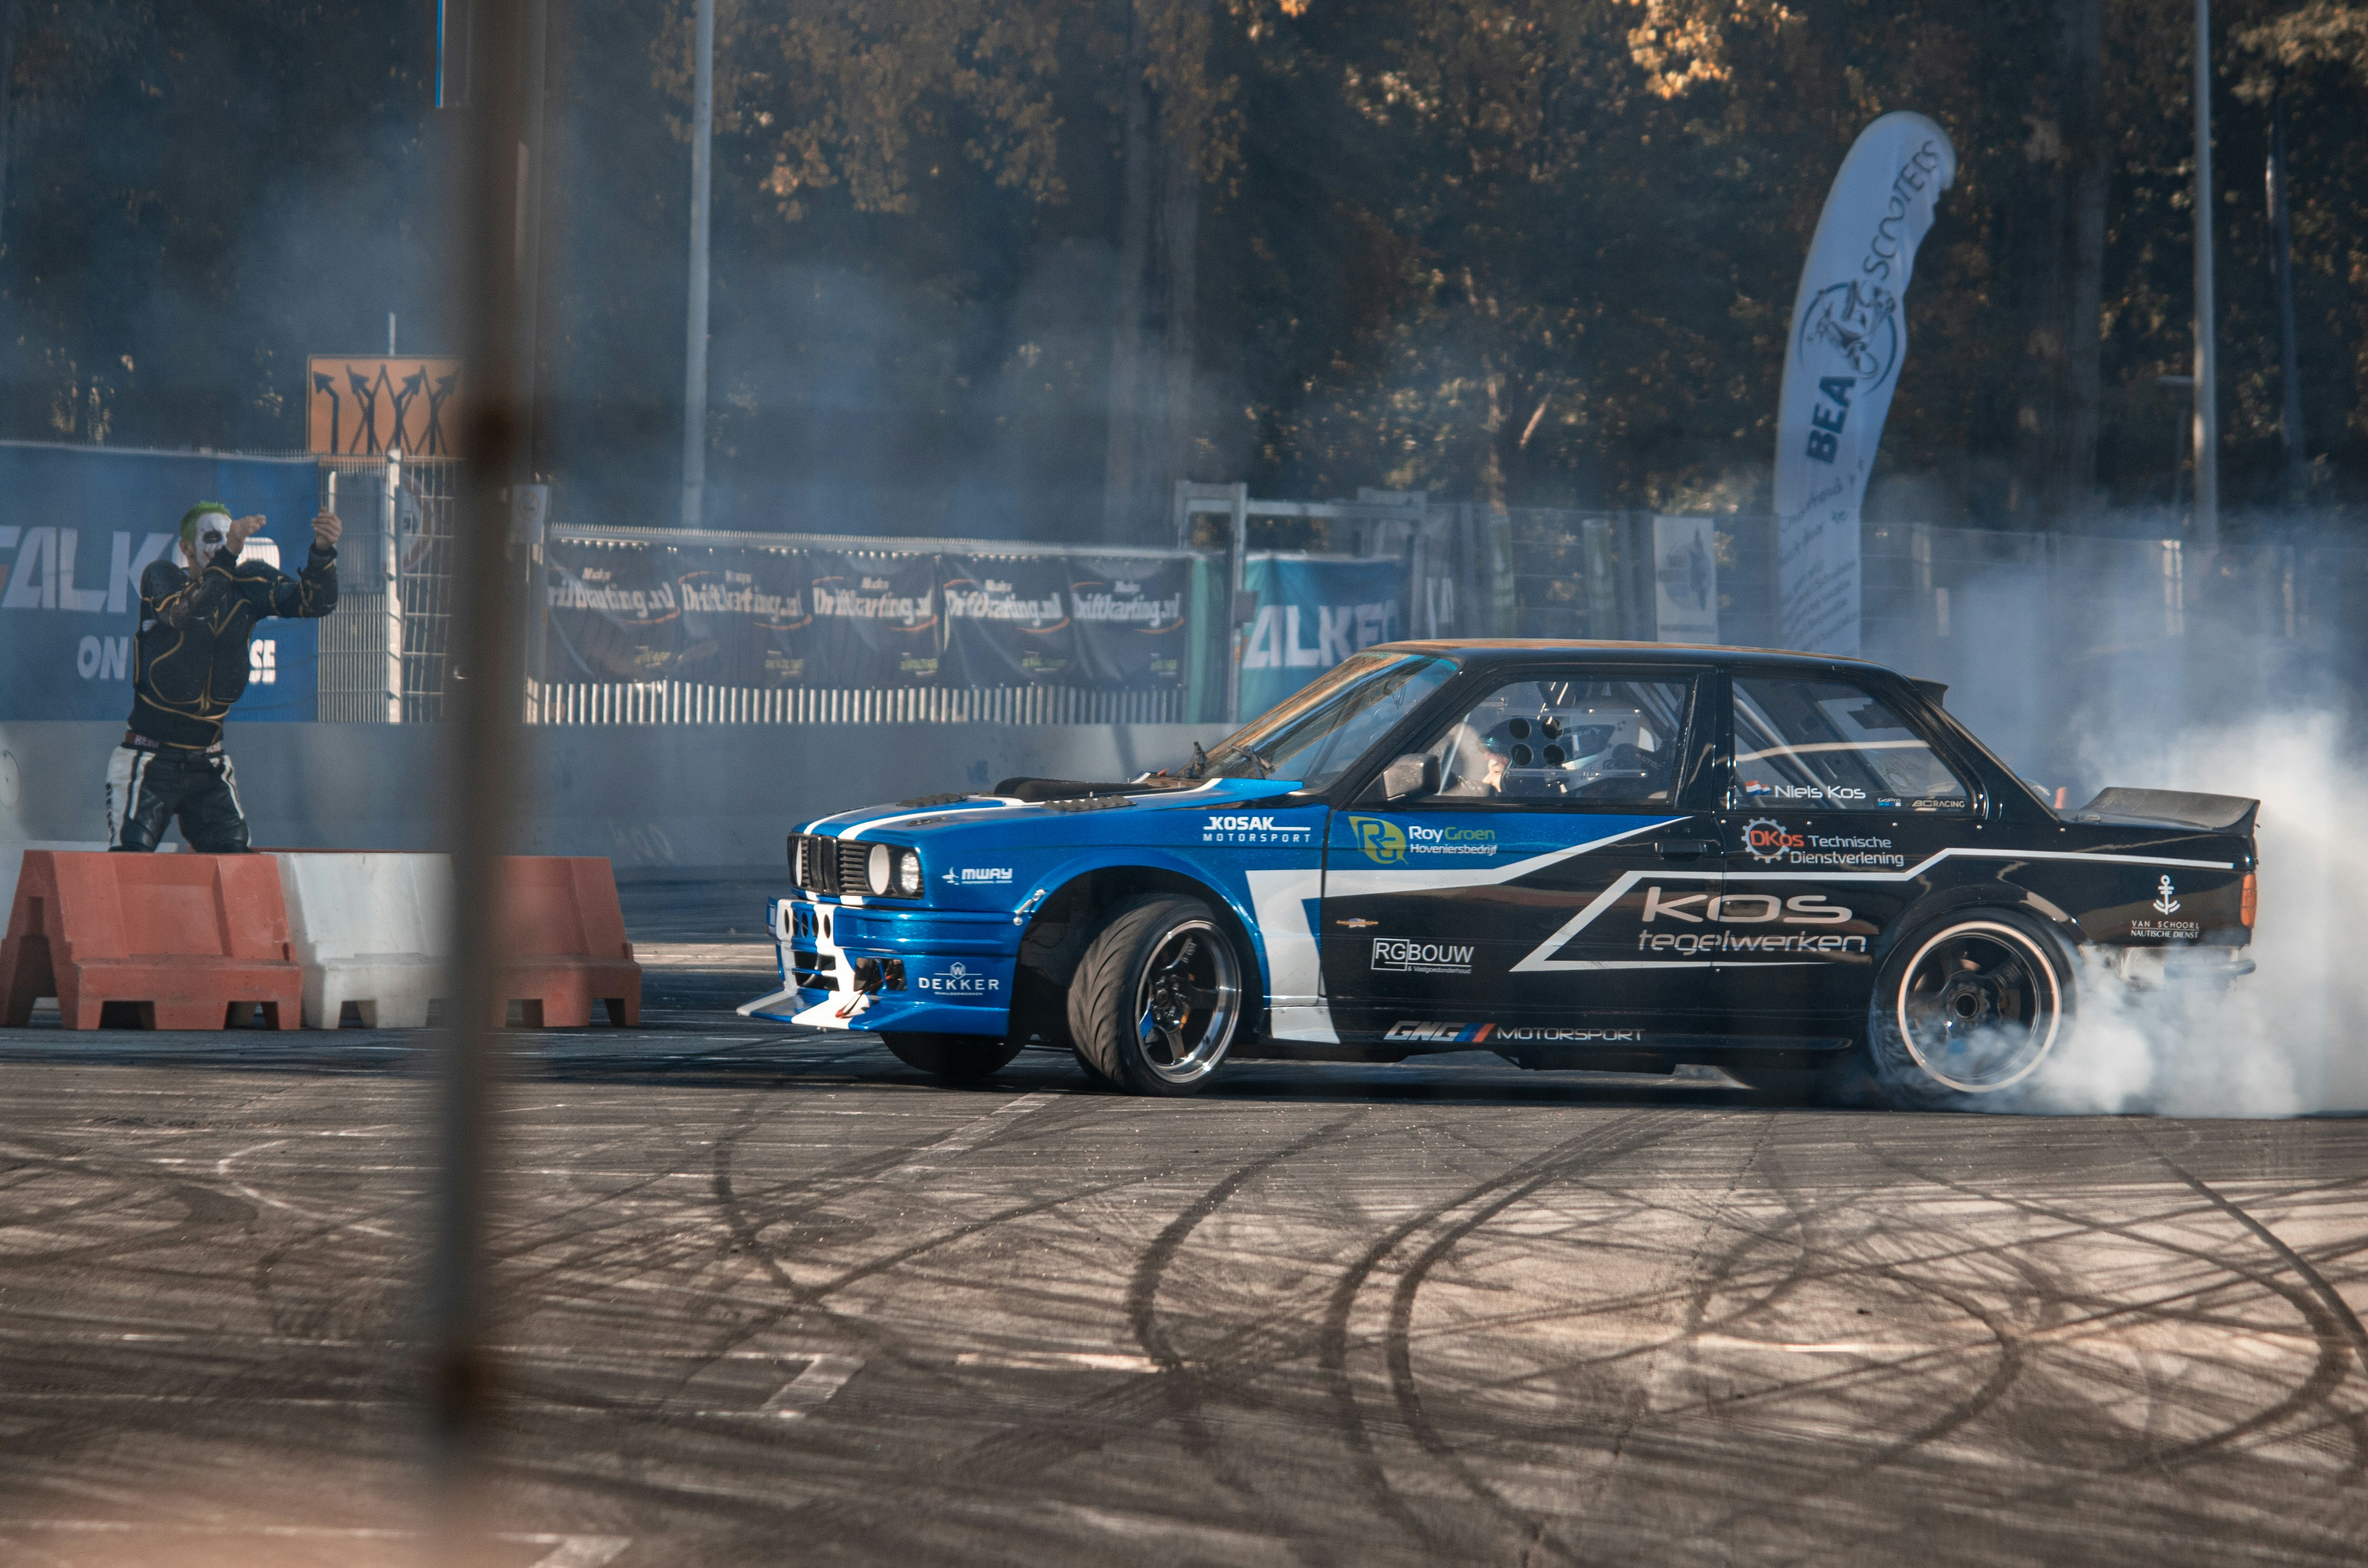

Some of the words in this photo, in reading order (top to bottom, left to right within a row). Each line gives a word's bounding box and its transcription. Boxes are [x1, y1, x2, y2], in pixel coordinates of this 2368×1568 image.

[1806, 376, 1856, 464] BEA
[77, 635, 129, 680] ON
[1775, 785, 1823, 798] Niels
[1828, 786, 1866, 799] Kos
[1203, 817, 1275, 831] KOSAK
[1203, 833, 1311, 842] MOTORSPORT
[1808, 835, 1892, 848] Technische
[1410, 844, 1498, 856] Hoveniersbedrijf
[1791, 851, 1904, 867] Dienstverlening
[2158, 921, 2199, 929] SCHOORL
[2130, 930, 2172, 938] NAUTISCHE
[1639, 930, 1866, 956] tegelwerken
[918, 977, 1000, 990] DEKKER
[1497, 1026, 1646, 1041] MOTORSPORT
